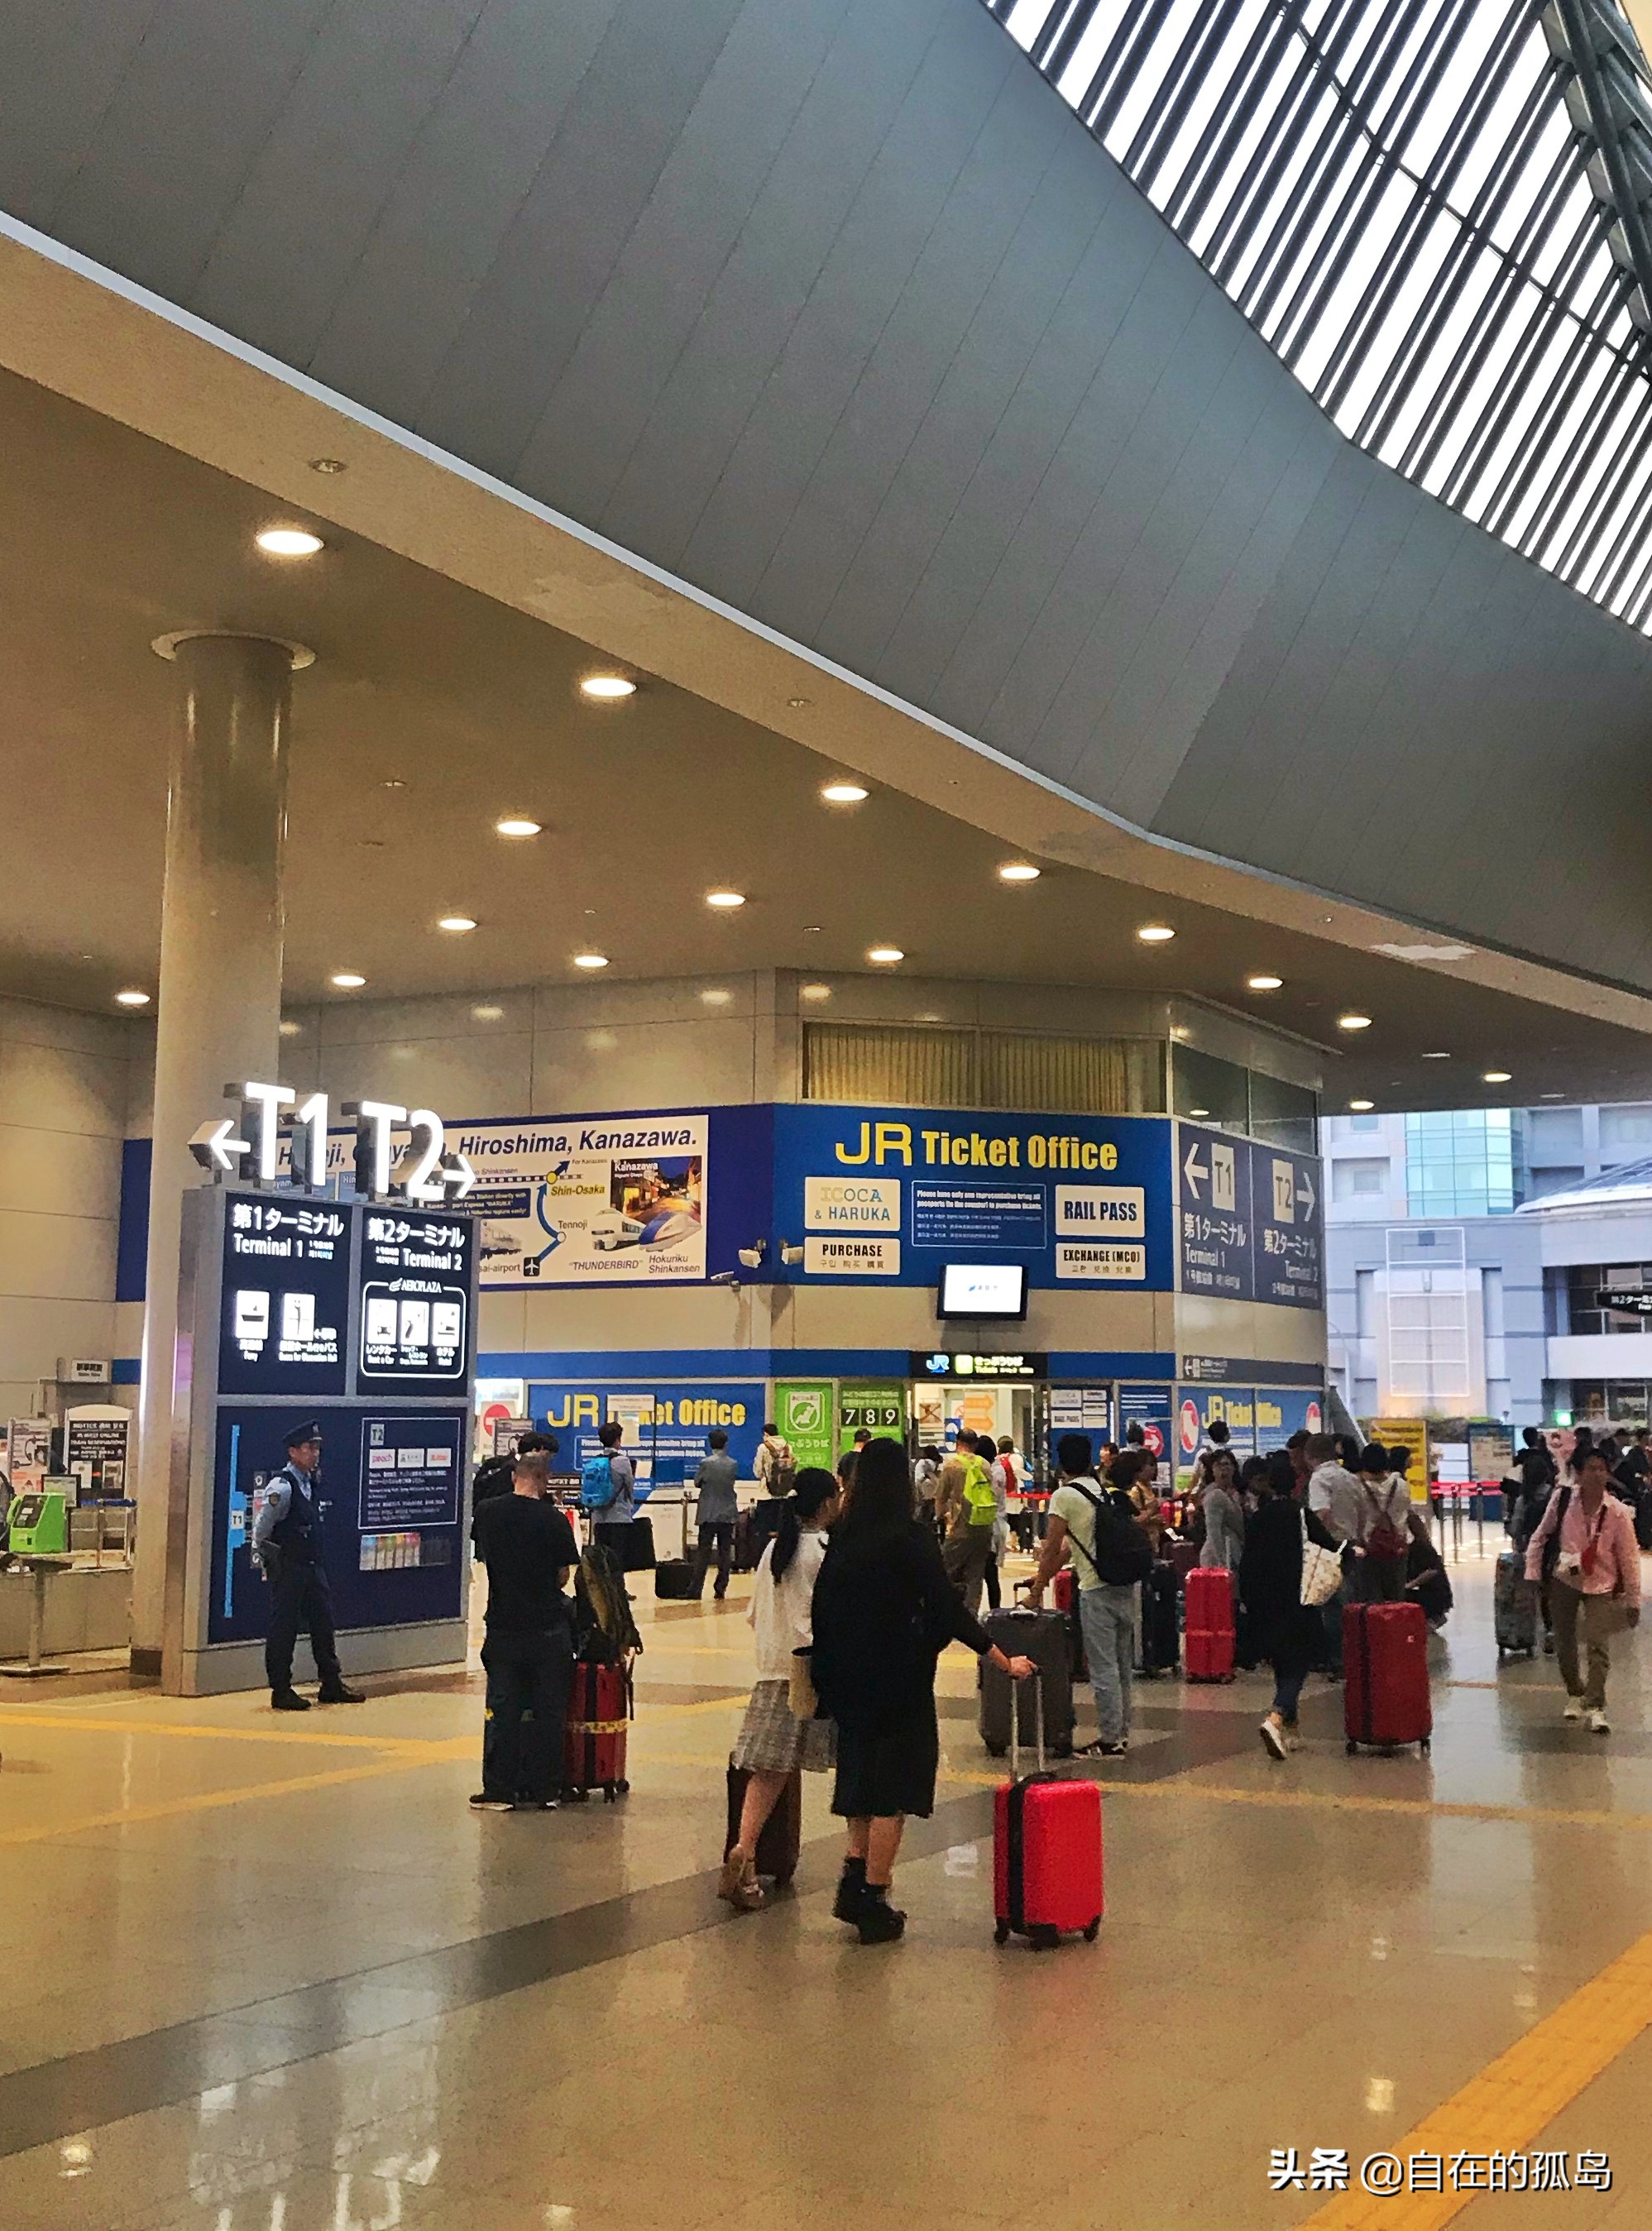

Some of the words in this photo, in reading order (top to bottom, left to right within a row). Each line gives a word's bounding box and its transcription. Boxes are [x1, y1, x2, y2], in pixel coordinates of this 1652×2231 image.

[245, 1081, 328, 1185] T1
[459, 1132, 572, 1156] Hiroshima,
[579, 1127, 697, 1151] Kanazawa.
[361, 1100, 444, 1200] T2
[835, 1122, 912, 1166] JR
[921, 1130, 1021, 1167] Ticket
[1027, 1134, 1118, 1171] Office
[615, 1161, 658, 1172] Kanazawa
[1214, 1161, 1233, 1196] T1
[551, 1185, 606, 1196] Shin-Osaka
[821, 1187, 883, 1203] ICOCA
[1276, 1175, 1292, 1210] T2
[232, 1202, 345, 1236] 第1ターミナル
[814, 1209, 822, 1220] &
[829, 1206, 891, 1221] HARUKA
[1064, 1200, 1096, 1220] RAIL
[1099, 1201, 1137, 1221] PASS
[367, 1217, 466, 1248] 第2ターミナル
[558, 1220, 588, 1229] Tennoji
[1184, 1212, 1247, 1247] 第1ターミナル
[233, 1233, 291, 1257] Terminal
[296, 1239, 304, 1257] 1
[822, 1244, 883, 1257] PURCHASE
[1185, 1242, 1219, 1266] Terminal
[403, 1247, 452, 1270] Terminal
[454, 1253, 462, 1271] 2
[649, 1254, 689, 1264] Hokuriku
[1063, 1249, 1110, 1262] EXCHANGE
[1112, 1251, 1141, 1263] (MCO)
[649, 1264, 701, 1274] Shinkansen
[401, 1278, 443, 1293] AEROPLAZA
[926, 1355, 950, 1371] JR
[547, 1394, 600, 1428] JR
[678, 1399, 746, 1426] Office
[845, 1409, 856, 1424] 7
[865, 1409, 876, 1424] 8
[885, 1409, 896, 1424] 9
[372, 1429, 384, 1441] T2
[232, 1515, 242, 1525] T1
